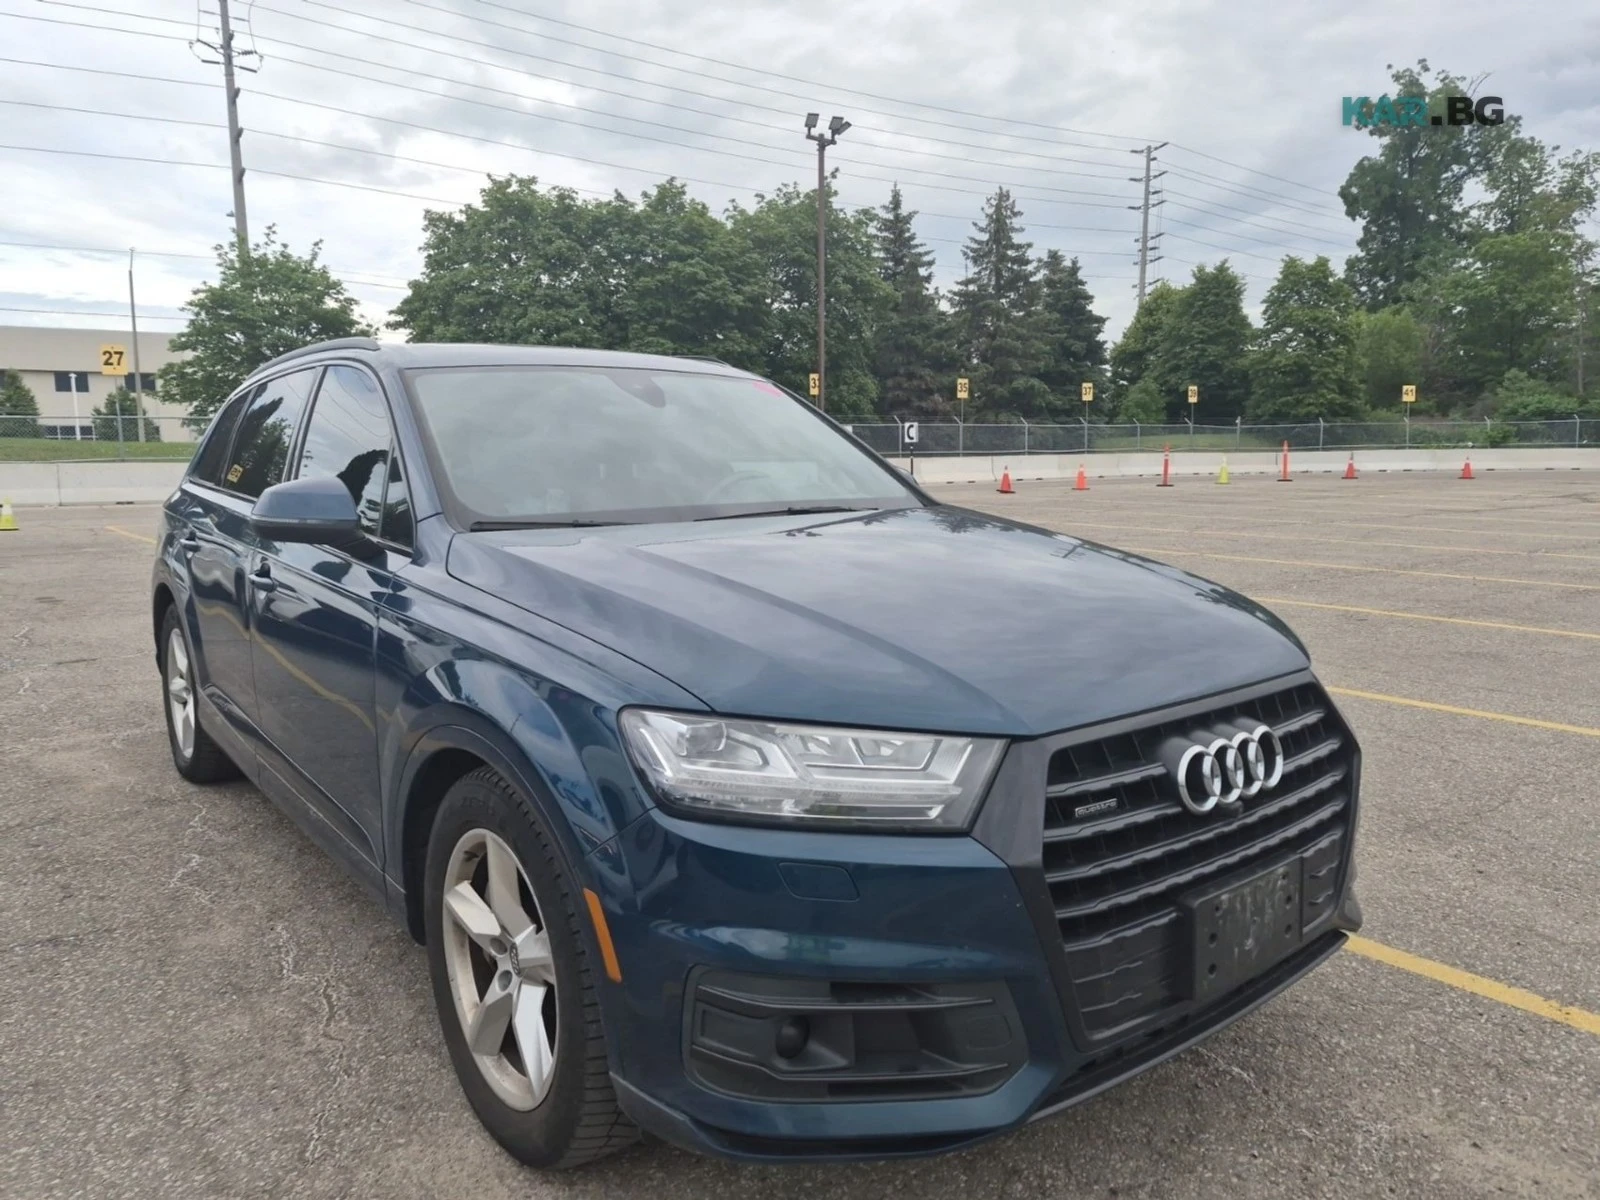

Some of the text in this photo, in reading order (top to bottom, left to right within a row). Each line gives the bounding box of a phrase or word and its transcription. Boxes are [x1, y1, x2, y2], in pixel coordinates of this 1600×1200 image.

[102, 350, 124, 366] 27
[957, 382, 968, 393] 35
[1083, 386, 1092, 396] 37
[1403, 388, 1414, 397] 41
[906, 424, 915, 441] C
